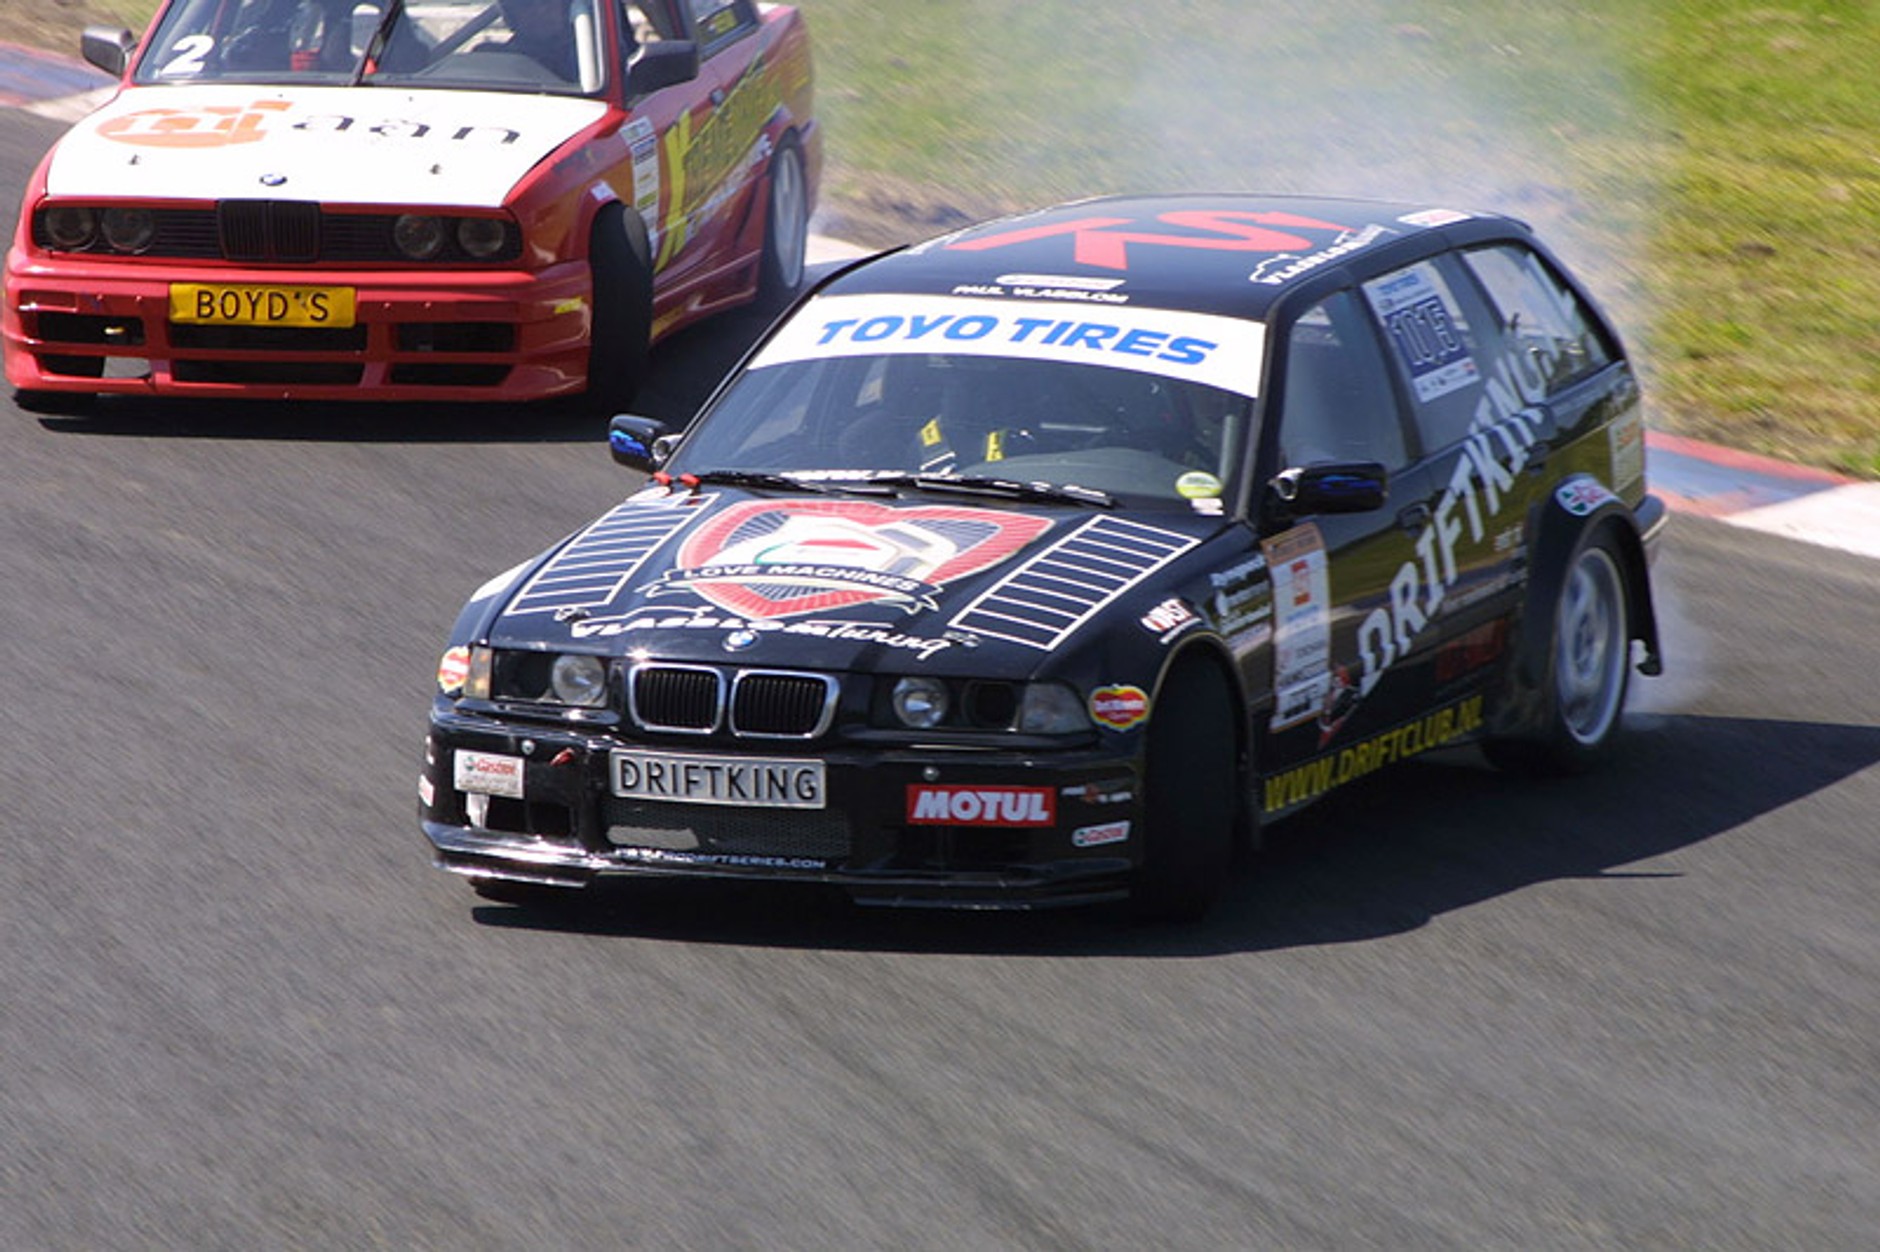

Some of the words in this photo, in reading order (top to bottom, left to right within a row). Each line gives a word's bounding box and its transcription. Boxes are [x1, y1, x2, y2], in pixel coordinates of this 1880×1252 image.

[160, 35, 215, 75] 2
[195, 289, 330, 322] BOYD'S
[815, 313, 998, 347] TOYO
[1012, 316, 1218, 367] TIRES
[682, 564, 760, 579] LOVE
[766, 564, 922, 592] MACHINES
[1263, 695, 1484, 812] WWW.DRIFTCLUB.NL
[618, 757, 819, 803] DRIFTKING
[913, 789, 1051, 822] MOTUL
